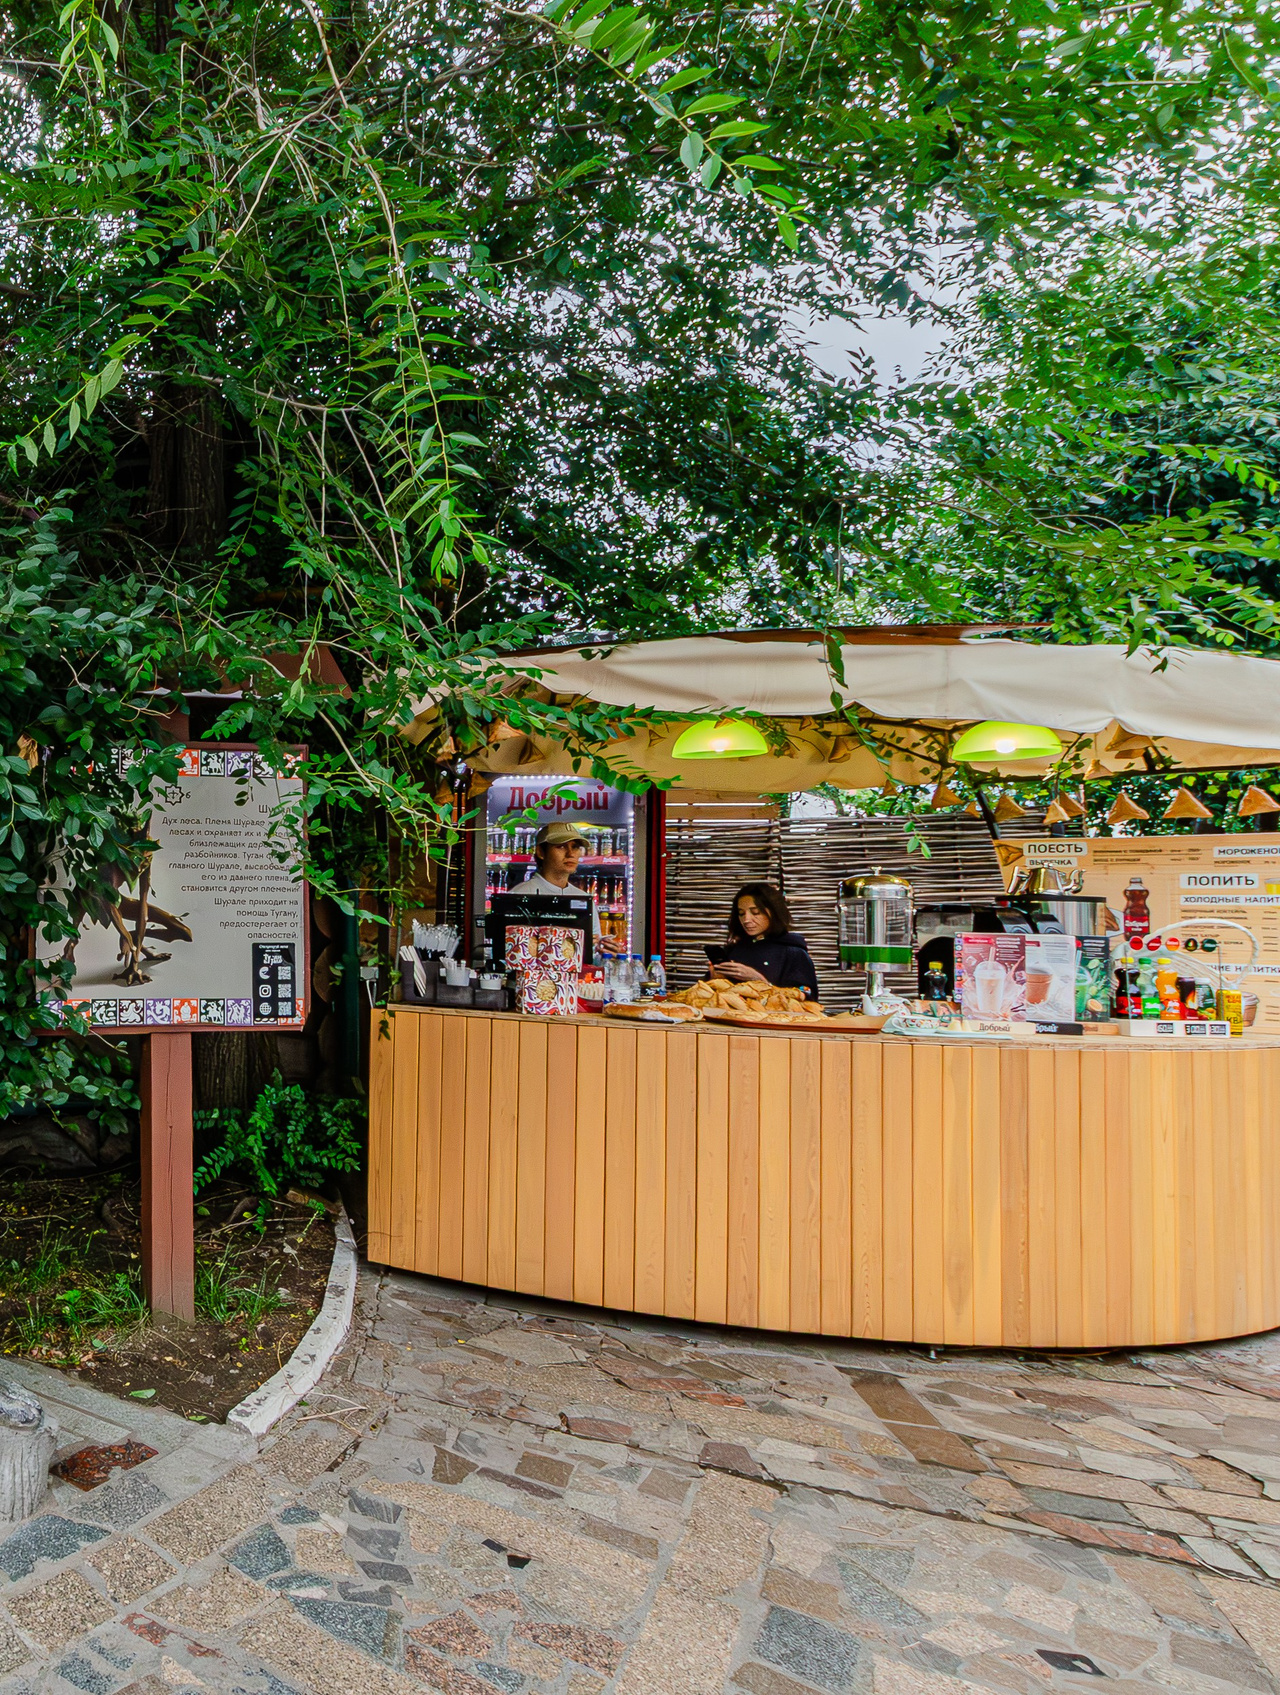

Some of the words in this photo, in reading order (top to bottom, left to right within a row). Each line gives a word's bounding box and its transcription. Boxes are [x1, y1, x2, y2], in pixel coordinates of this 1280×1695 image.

[507, 785, 609, 815] Добрый
[162, 817, 177, 828] Дух
[205, 817, 231, 826] Племя
[233, 818, 265, 828] Шурале
[204, 830, 242, 839] охраняет
[189, 840, 246, 849] близлежащих
[1027, 844, 1083, 854] ПОЕСТЬ
[1218, 847, 1280, 856] МОРОЖЕНО
[184, 851, 240, 860] разбойников.
[243, 852, 264, 861] Туган
[168, 862, 205, 870] главного
[208, 863, 242, 872] Шурале,
[1187, 876, 1255, 886] ПОПИТЬ
[229, 885, 258, 894] другом
[214, 898, 246, 908] Шурале
[249, 899, 287, 908] приходит
[1183, 896, 1240, 904] ХОЛОДНЫЕ
[271, 909, 299, 918] Тугану,
[219, 921, 287, 929] предостерегает
[247, 931, 299, 939] опасностей.
